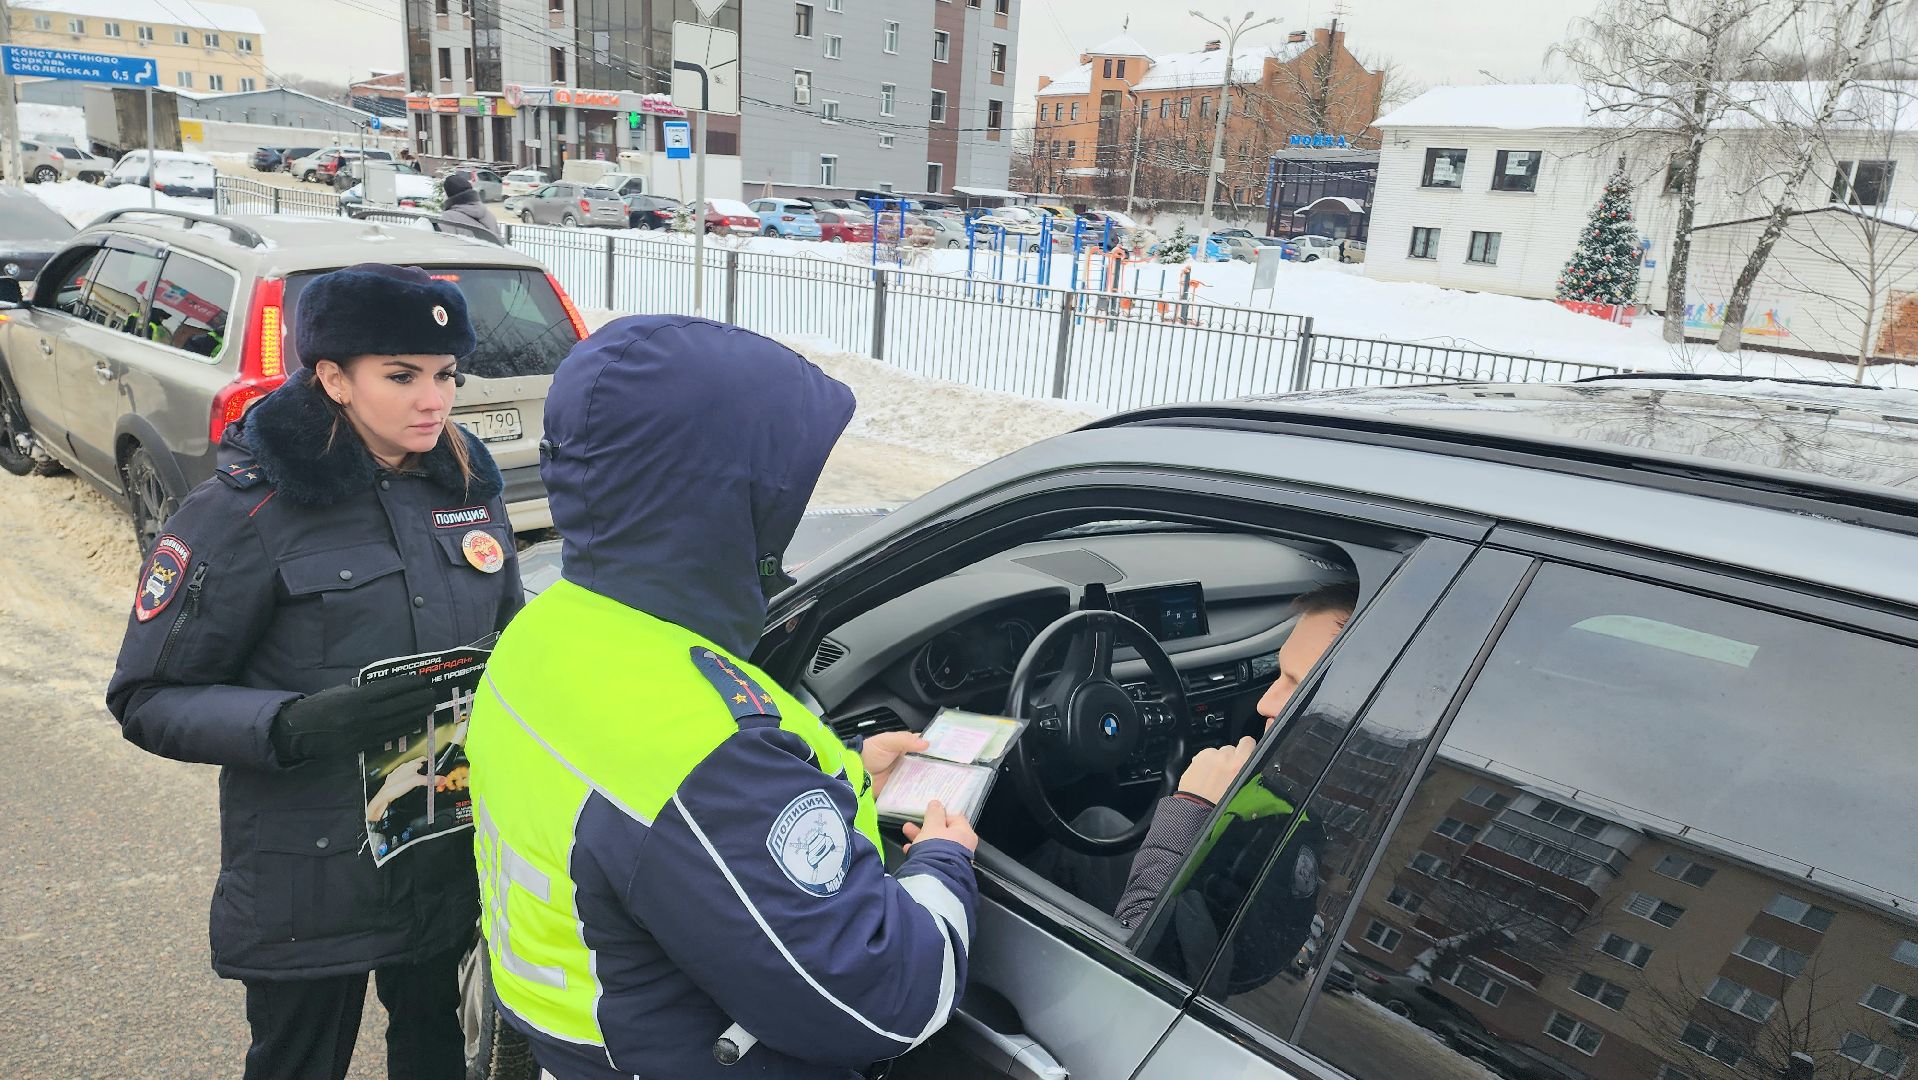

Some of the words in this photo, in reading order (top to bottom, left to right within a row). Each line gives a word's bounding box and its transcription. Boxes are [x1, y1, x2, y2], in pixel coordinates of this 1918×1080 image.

[10, 48, 119, 64] КОНСТАНТИНОВО
[12, 63, 100, 77] СМОЛЕНСКАЯ
[1290, 131, 1345, 147] МОЙКА
[486, 413, 514, 429] 790
[435, 508, 488, 524] ПОЛИЦИЯ
[366, 668, 389, 680] ЭТОТ
[391, 657, 442, 674] КРОССВОРД
[431, 675, 442, 684] НЕ
[774, 797, 826, 850] ПОЛИЦИЯ
